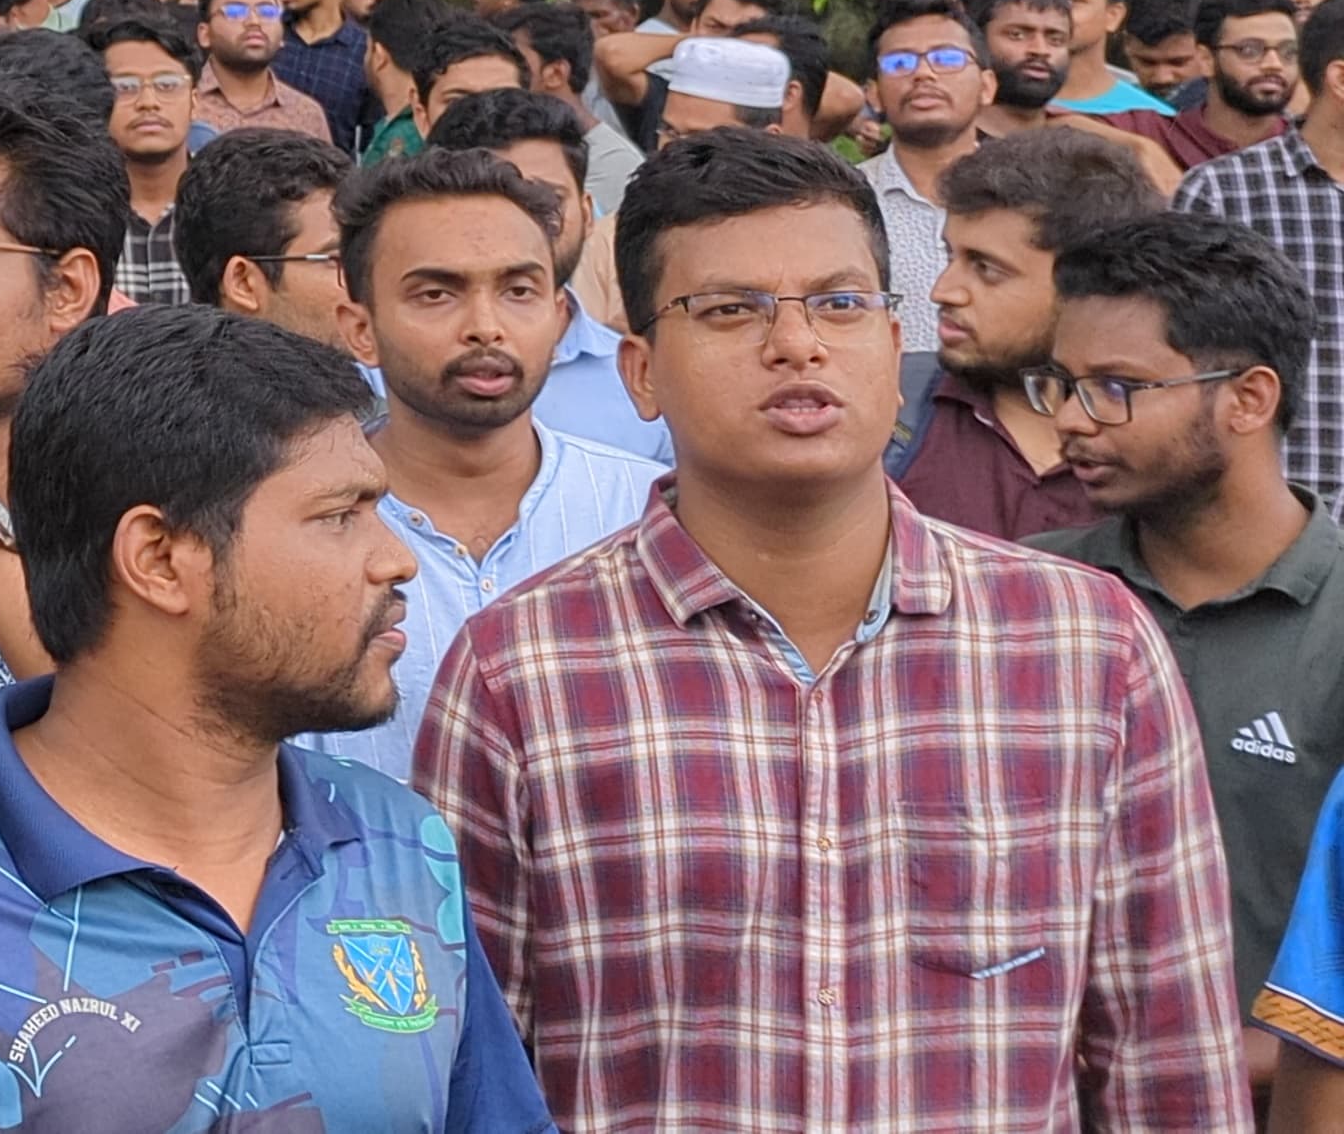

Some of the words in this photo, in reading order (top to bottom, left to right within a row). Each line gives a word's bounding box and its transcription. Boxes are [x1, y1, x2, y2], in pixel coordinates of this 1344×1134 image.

[1231, 737, 1296, 764] adidas
[9, 1003, 60, 1063] SHAHEED
[59, 997, 118, 1020] NAZRUL
[120, 1011, 142, 1034] XI
